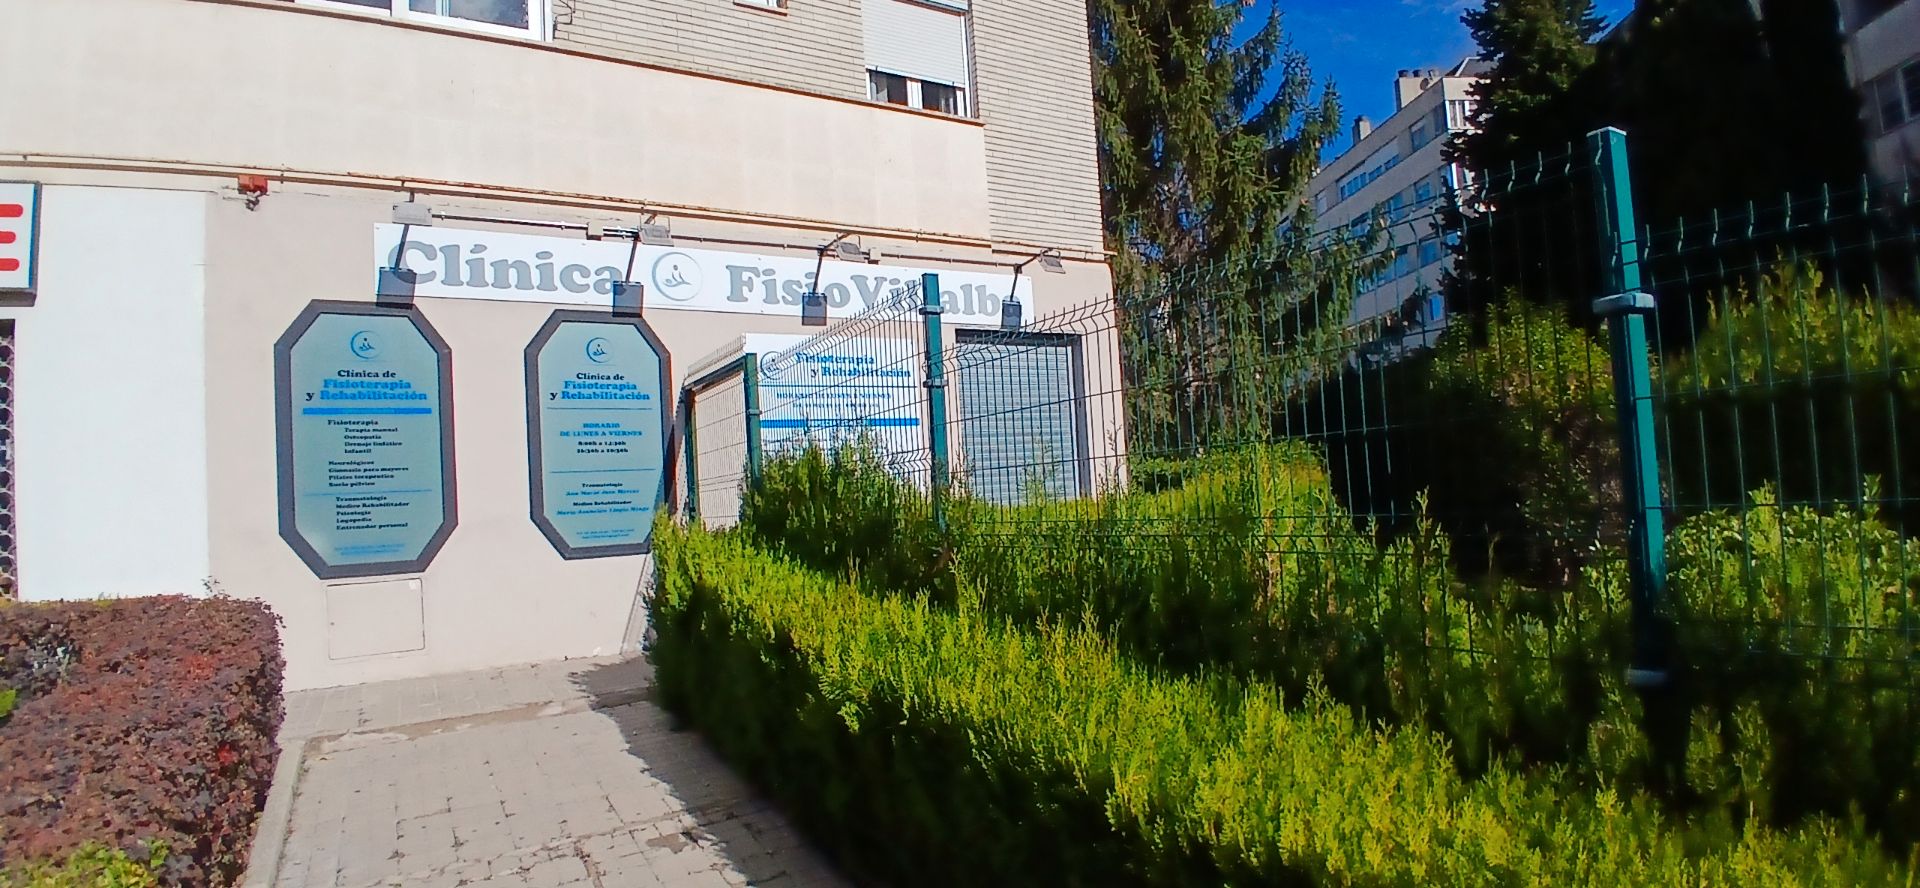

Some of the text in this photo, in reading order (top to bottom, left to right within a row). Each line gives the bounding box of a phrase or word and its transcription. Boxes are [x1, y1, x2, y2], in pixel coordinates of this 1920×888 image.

[388, 240, 627, 295] Clínica
[382, 370, 396, 378] de
[613, 373, 625, 381] de
[564, 380, 638, 391] Fisioterapia
[305, 390, 428, 401] y Rehabilitación
[550, 390, 650, 400] y Rehabilitación
